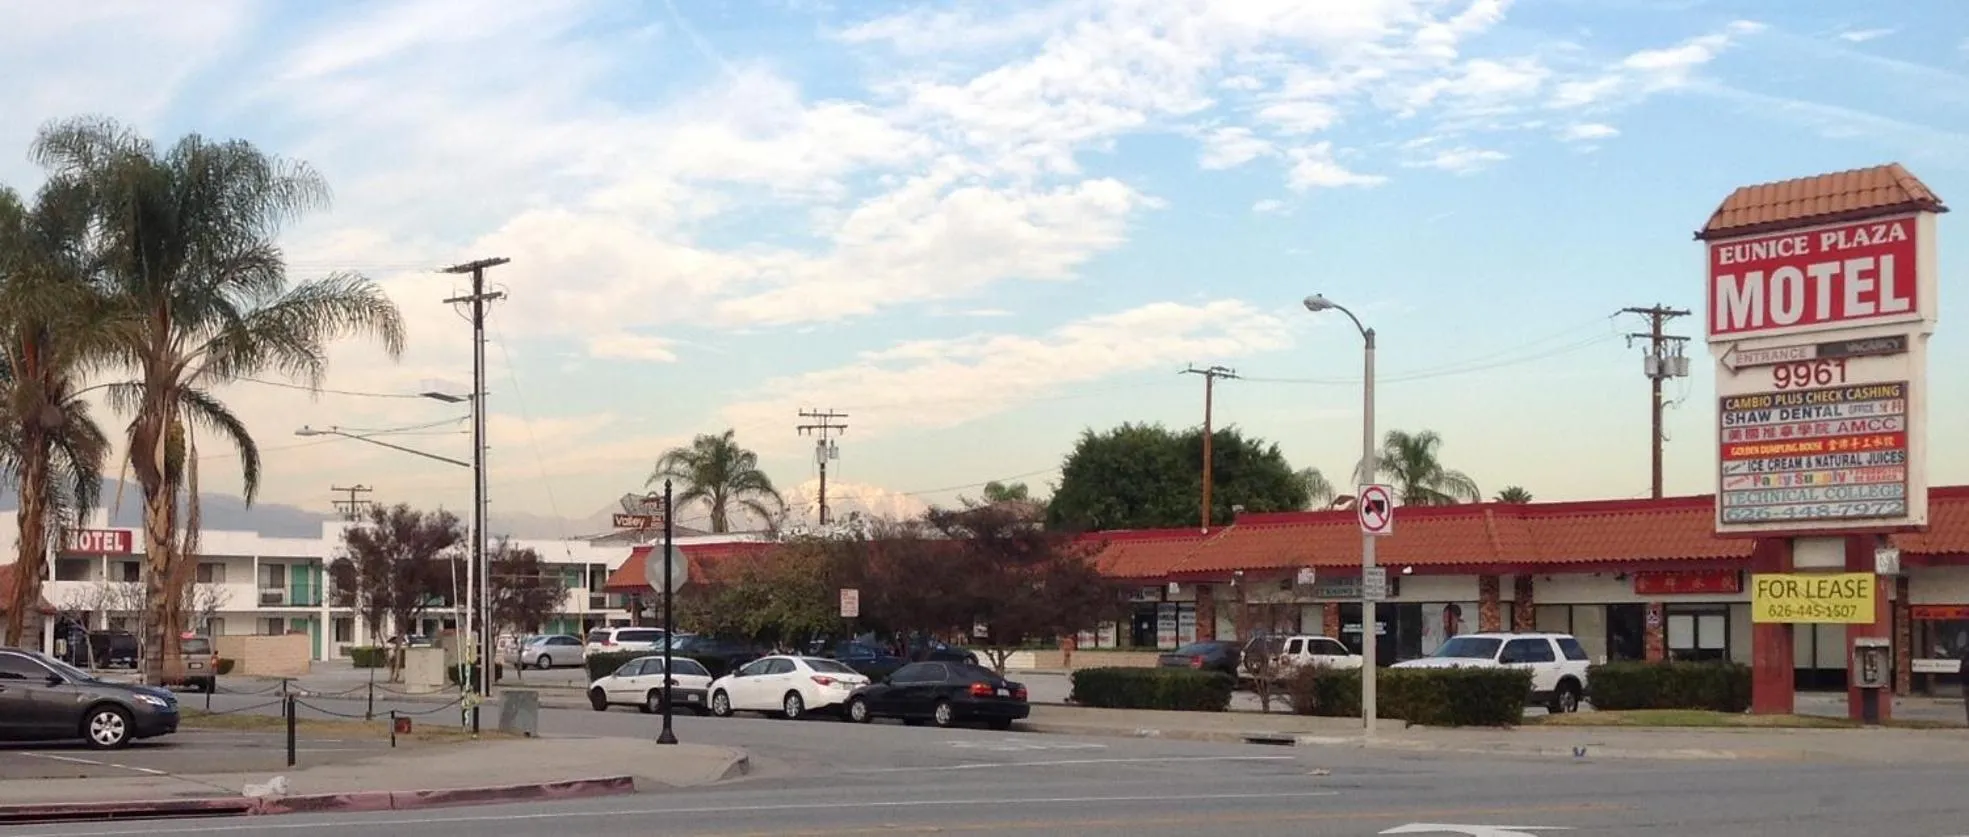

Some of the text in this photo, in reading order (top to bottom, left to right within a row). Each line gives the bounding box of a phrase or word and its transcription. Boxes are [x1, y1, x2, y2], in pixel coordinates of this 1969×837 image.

[1720, 222, 1907, 265] EUNICE PLAZA
[1716, 254, 1910, 331] MOTEL
[1735, 348, 1808, 364] ENTRANCE
[1773, 358, 1847, 389] 9961
[1725, 385, 1900, 411] CAMBIO PLUS CHECK CASHING
[1725, 411, 1771, 425] SHAW
[1779, 405, 1843, 422] DENTAL
[1837, 418, 1897, 433] AMCC
[1731, 446, 1759, 456] GOLDEN
[1748, 459, 1763, 472] ICE
[1767, 456, 1802, 471] CREAM
[1815, 453, 1862, 468] NATURAL
[1867, 450, 1905, 464] JUICES
[1727, 483, 1904, 505] TECHNICAL COLLEGE
[1725, 501, 1903, 521] 626-448-7972
[615, 515, 645, 529] Valley
[1758, 579, 1798, 599] FOR
[1806, 579, 1868, 599] LEASE
